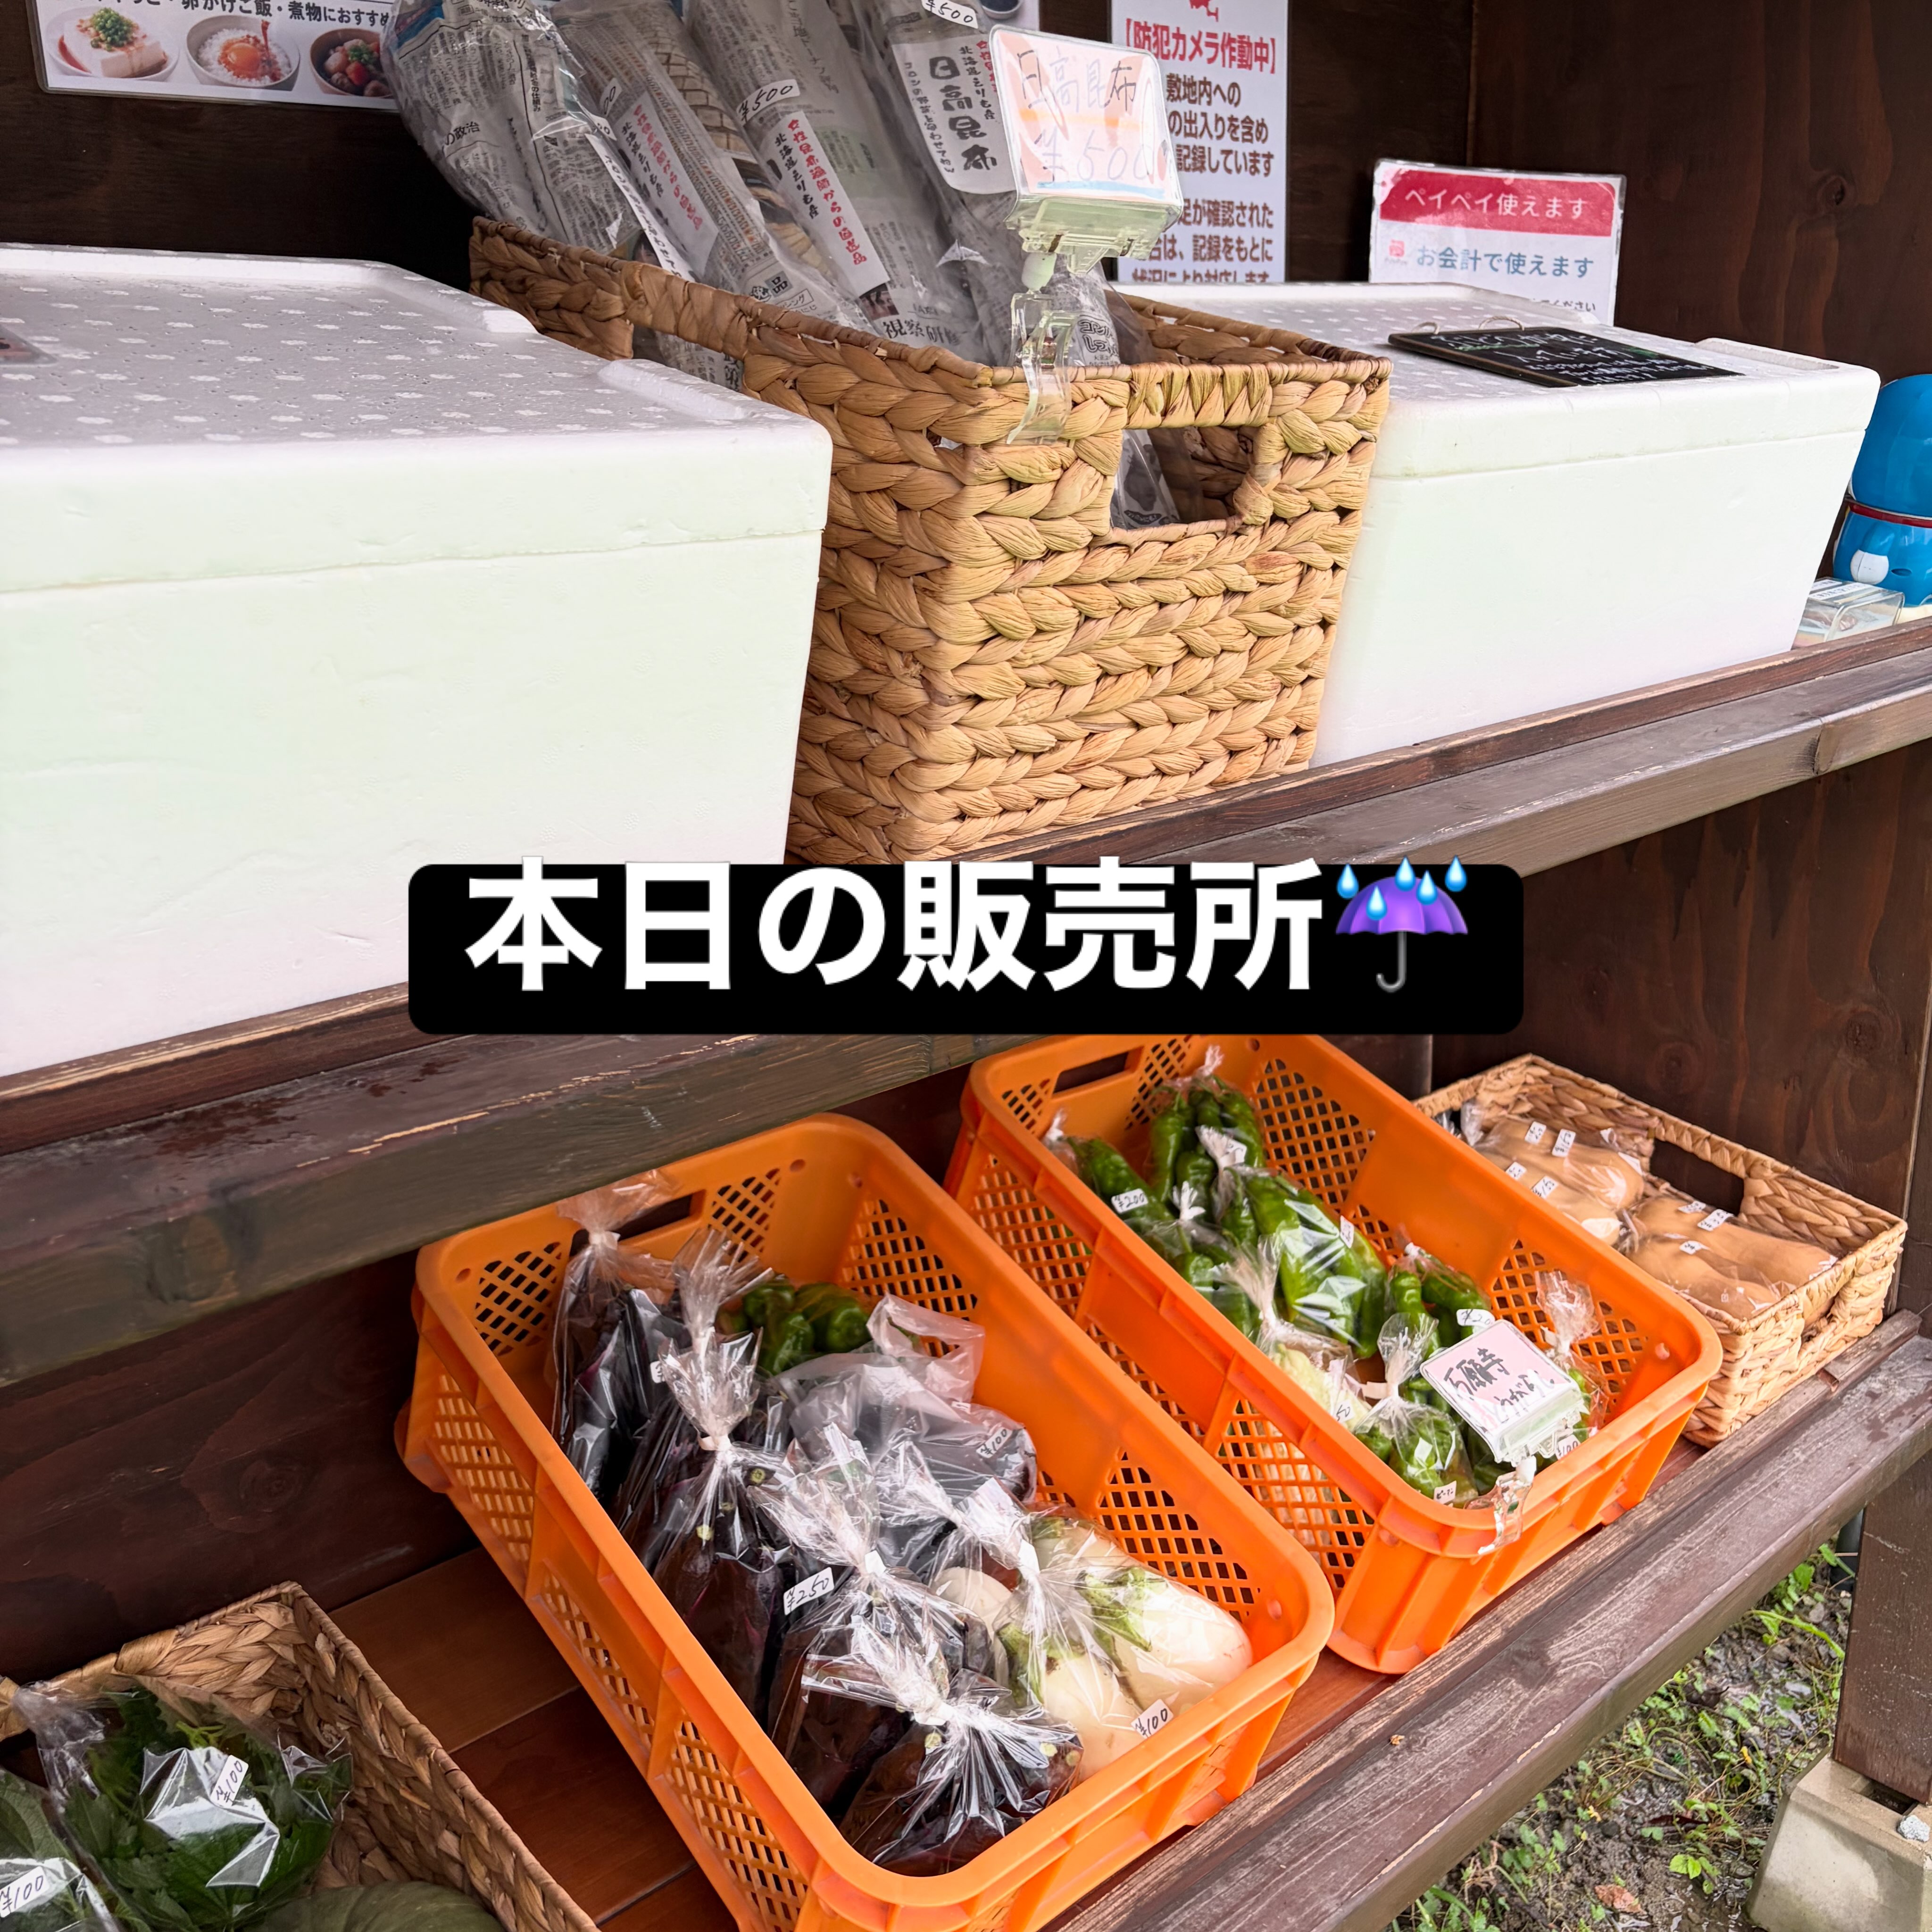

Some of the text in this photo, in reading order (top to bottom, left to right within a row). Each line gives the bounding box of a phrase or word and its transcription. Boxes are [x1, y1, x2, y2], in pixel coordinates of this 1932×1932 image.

[1017, 46, 1137, 112] 日高昆布
[1166, 73, 1241, 108] 敷地内への
[739, 85, 793, 122] ¥500
[929, 56, 998, 171] 日高昆布
[1175, 143, 1274, 177] 記録しています
[1405, 188, 1589, 221] ペイペイ使えます
[1416, 246, 1595, 279] お会計で使えます
[1461, 1309, 1494, 1325] ¥20
[980, 1428, 1008, 1455] ¥100
[786, 1574, 830, 1613] ¥250
[1134, 1707, 1168, 1739] ¥100
[216, 1760, 243, 1803] ¥100
[0, 1874, 44, 1913] ¥100
